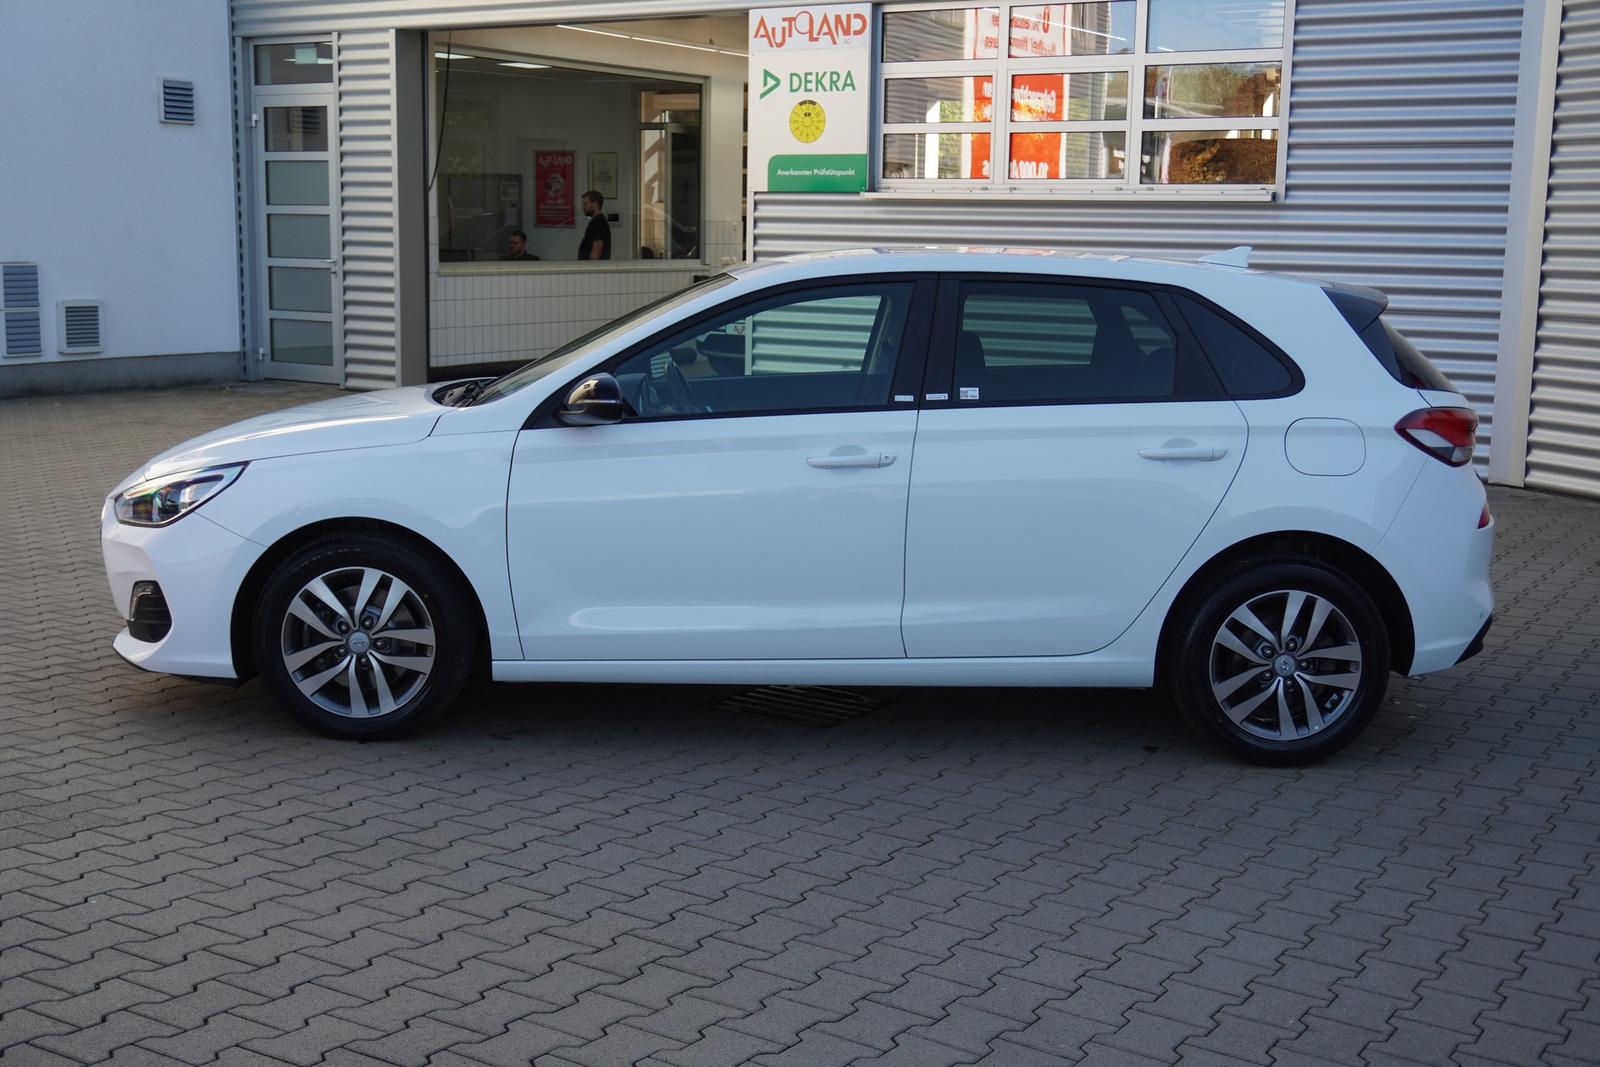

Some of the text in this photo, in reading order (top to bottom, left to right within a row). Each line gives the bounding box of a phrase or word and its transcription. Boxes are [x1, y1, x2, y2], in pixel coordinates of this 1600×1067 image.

[754, 10, 868, 48] AUTOLAND
[789, 70, 857, 93] DEKRA
[776, 168, 855, 177] Anerkannter Prüfstützpunkt
